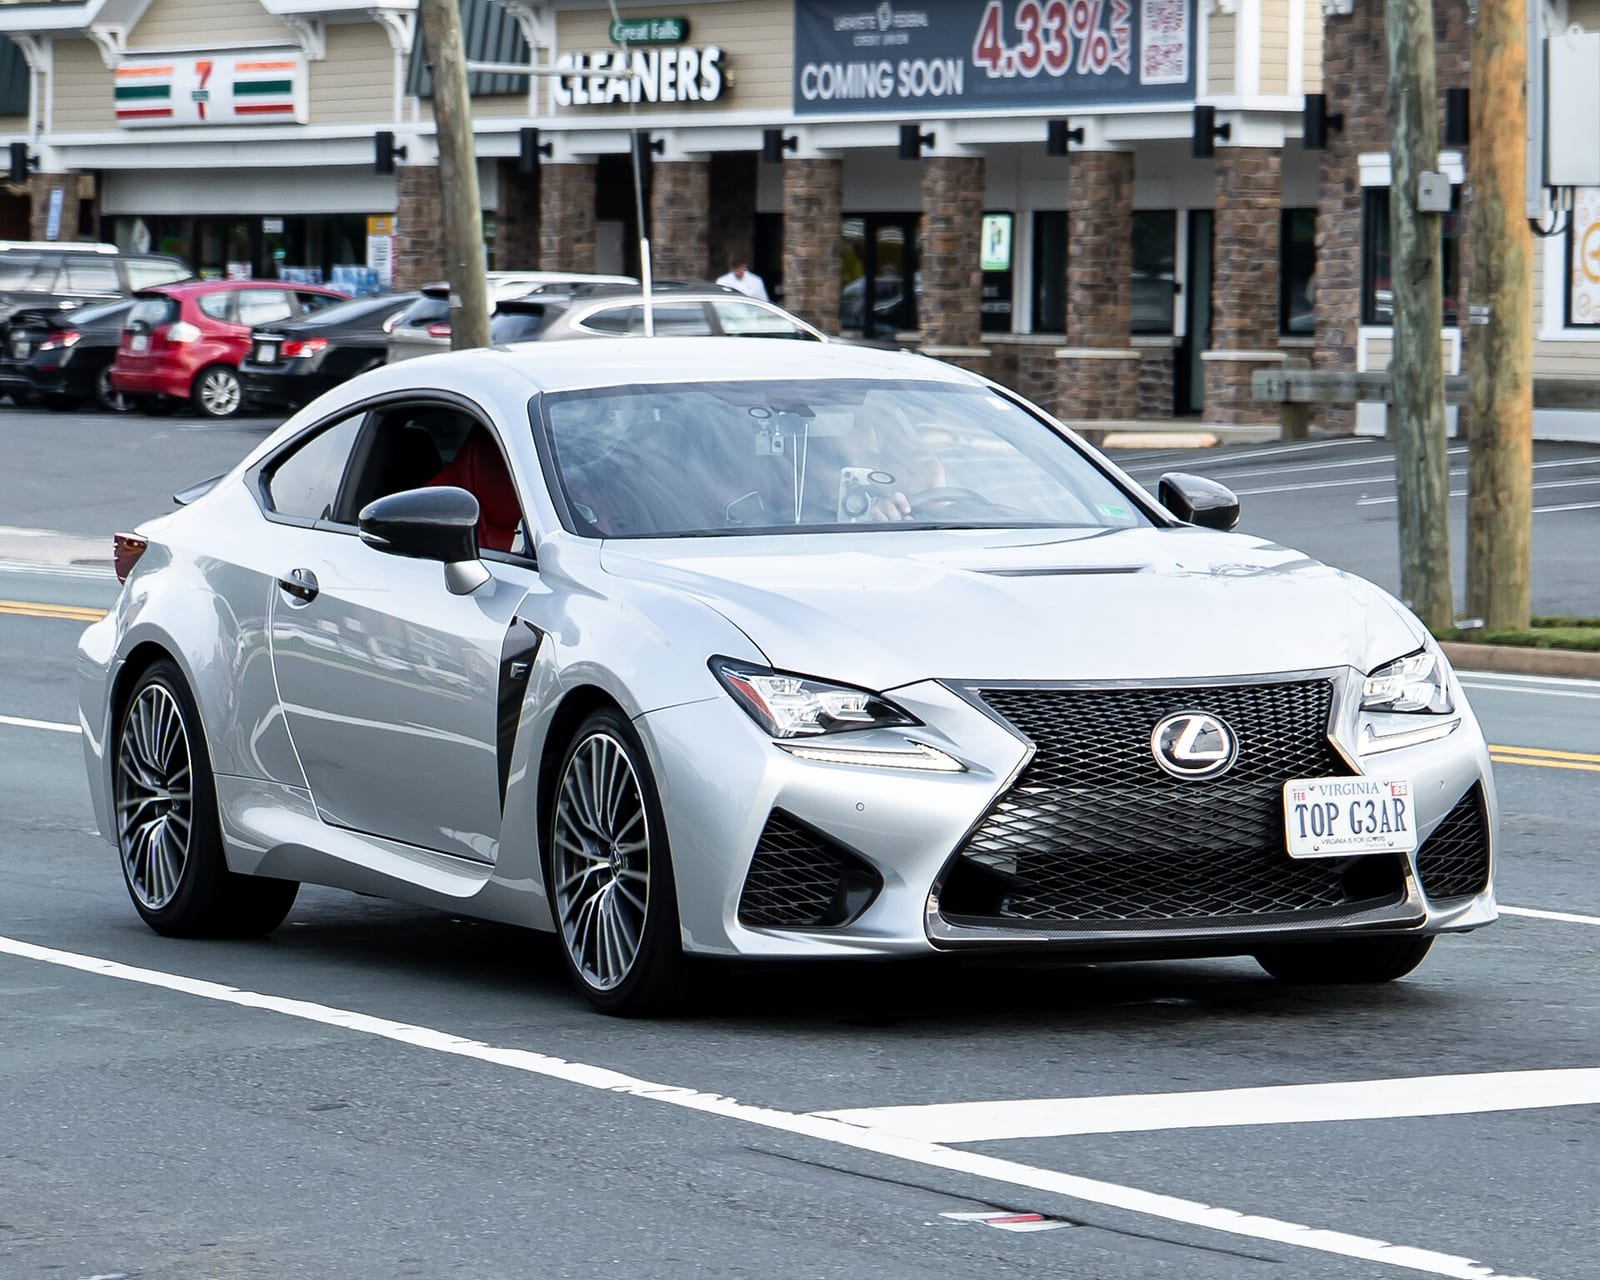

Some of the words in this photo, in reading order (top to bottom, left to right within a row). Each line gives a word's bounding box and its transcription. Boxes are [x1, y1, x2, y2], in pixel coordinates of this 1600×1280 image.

[613, 23, 649, 41] Great
[650, 20, 681, 40] Falls
[974, 0, 1110, 77] 4.33%
[1111, 0, 1130, 75] APY
[553, 45, 722, 106] CLEANERS
[801, 60, 895, 100] COMING
[898, 57, 964, 97] SOON
[1319, 782, 1380, 796] VIRGINIA
[1295, 802, 1339, 838] TOP
[1350, 798, 1407, 834] G3AR
